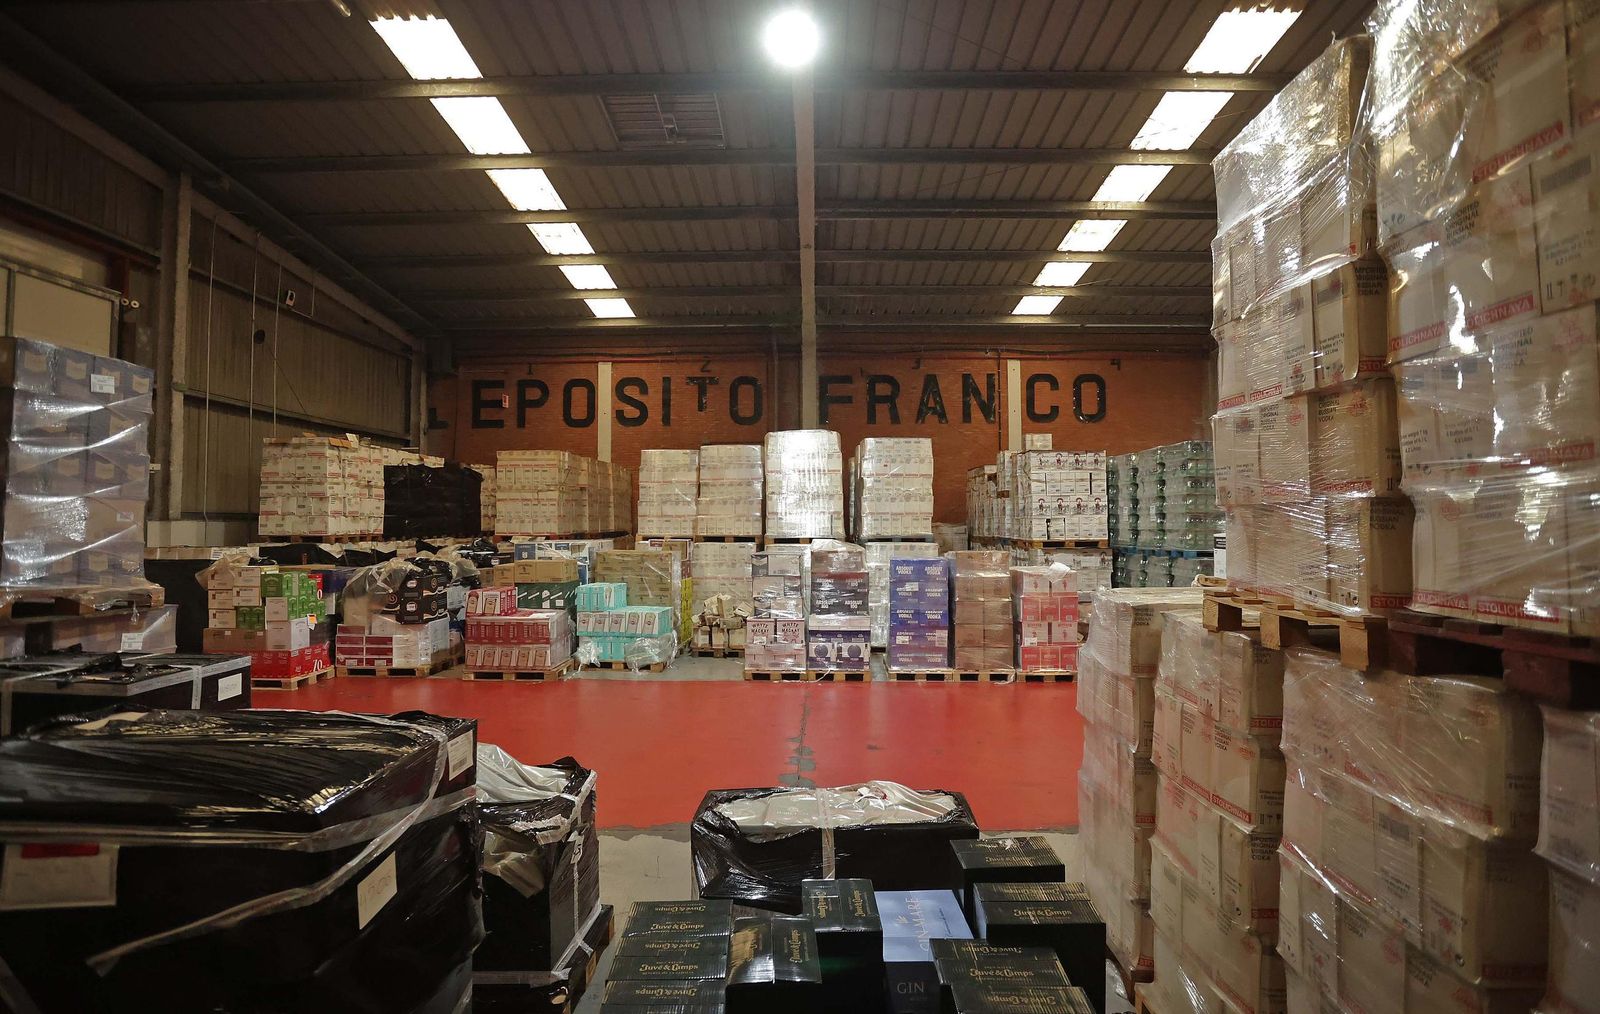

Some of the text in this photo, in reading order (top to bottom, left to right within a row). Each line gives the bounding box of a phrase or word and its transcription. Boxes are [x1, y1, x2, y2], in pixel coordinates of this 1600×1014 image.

[818, 373, 1107, 424] FRANCO
[1212, 794, 1252, 824] STOLICHNAYA
[671, 963, 698, 972] Camps
[1004, 968, 1034, 977] Camps
[896, 981, 924, 994] GIN
